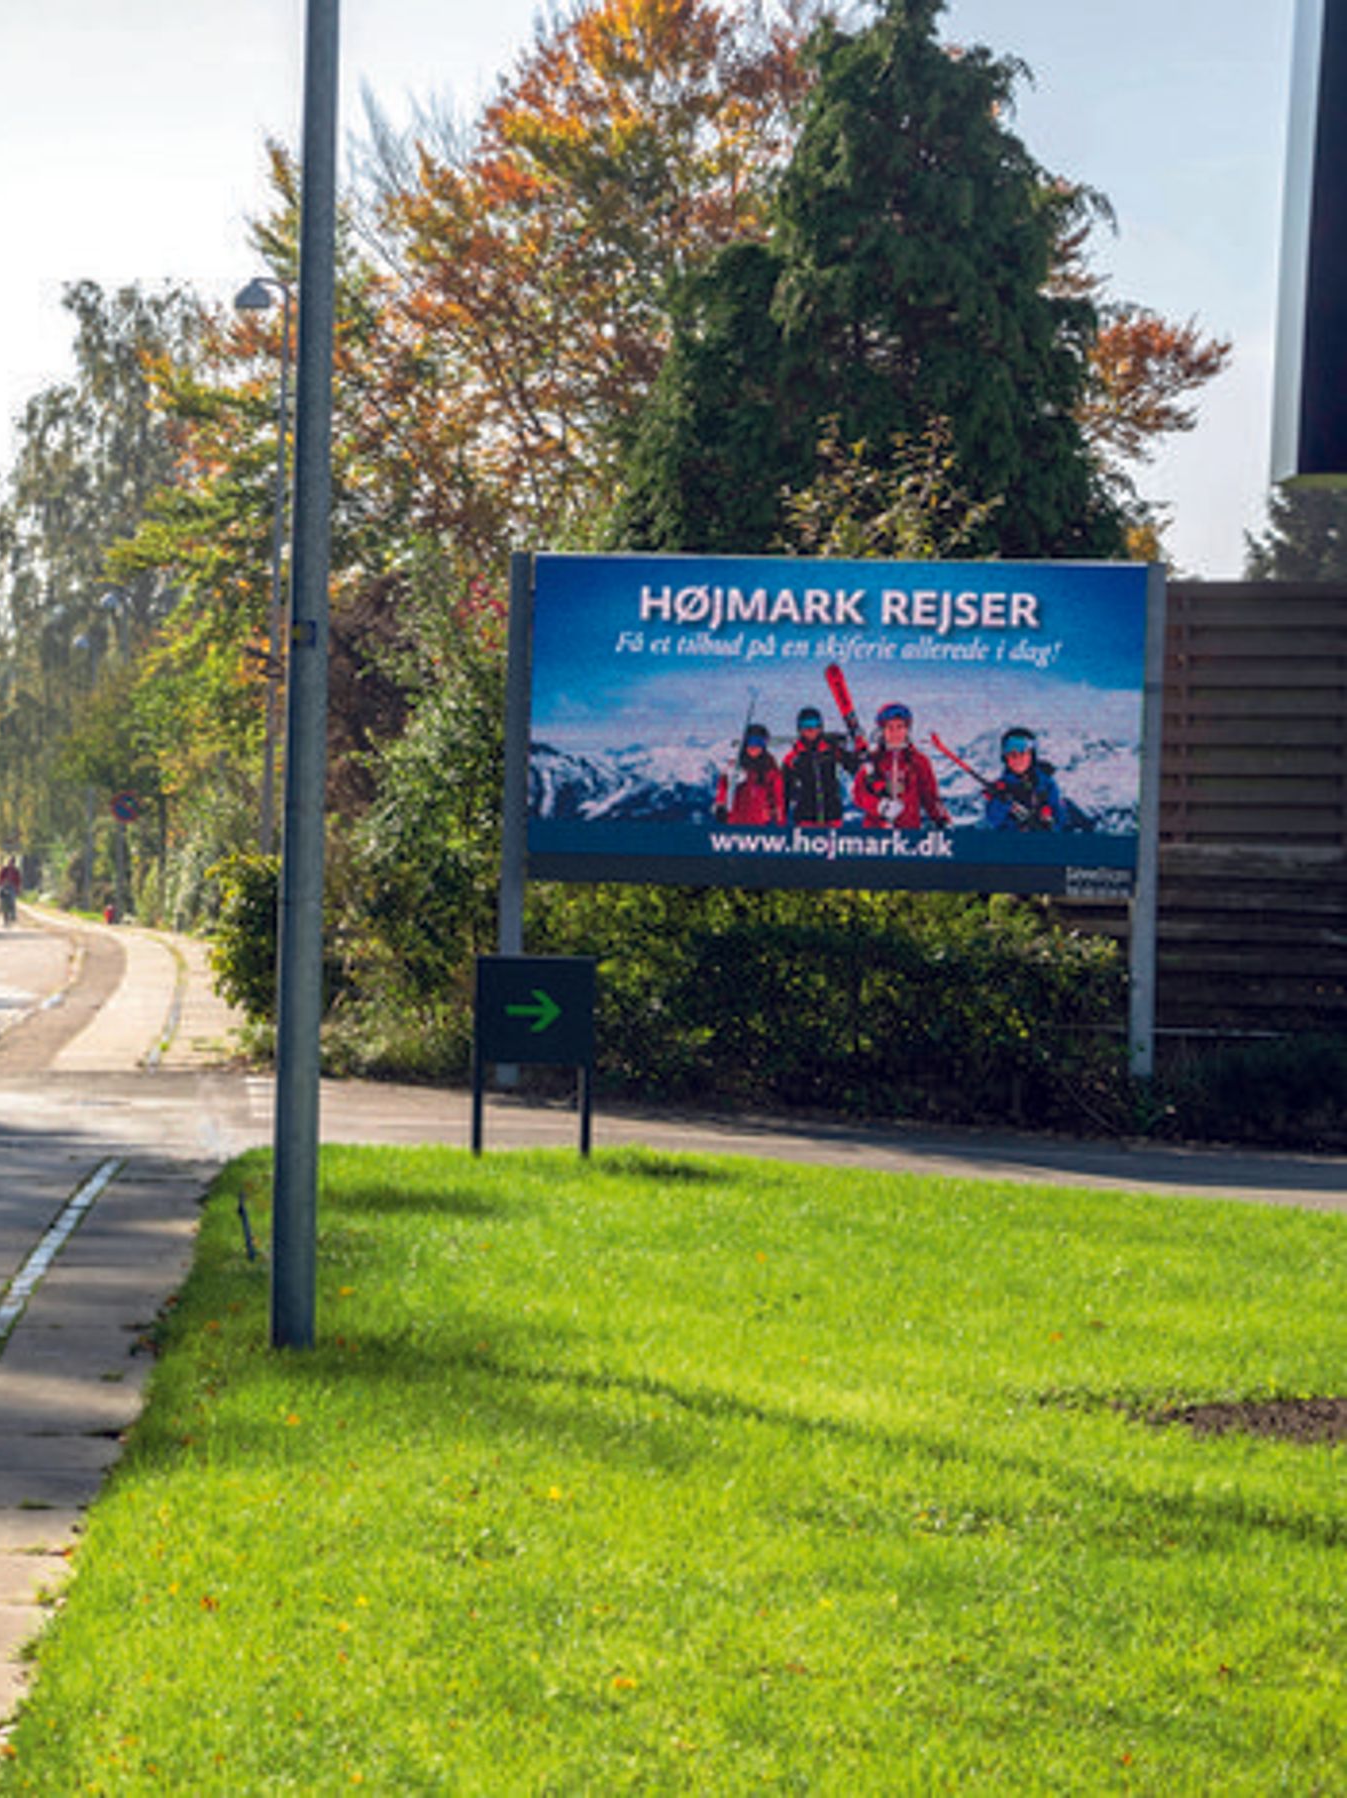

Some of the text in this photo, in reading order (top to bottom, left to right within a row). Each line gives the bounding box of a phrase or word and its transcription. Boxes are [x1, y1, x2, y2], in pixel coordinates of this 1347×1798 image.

[639, 582, 1040, 636] HØJMARK REJSER
[615, 630, 1064, 668] Få et tilbud på en skiferie allerede i dag!
[709, 827, 954, 861] www.hojmark.dk
